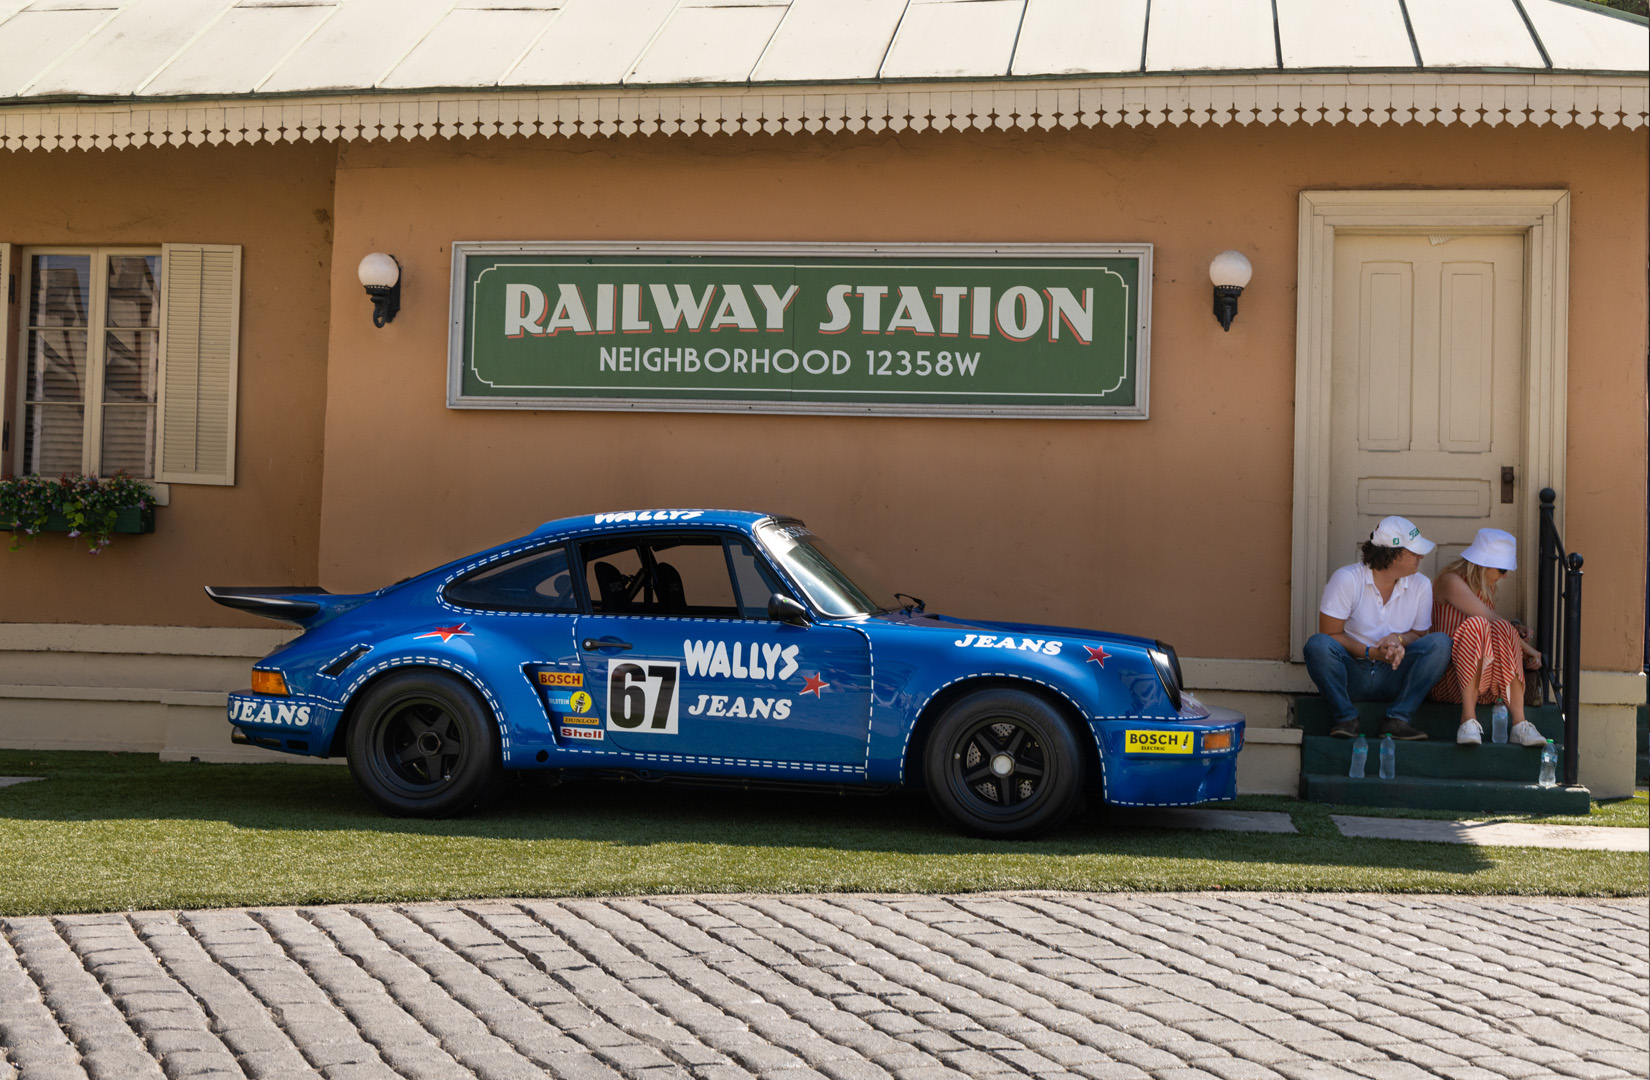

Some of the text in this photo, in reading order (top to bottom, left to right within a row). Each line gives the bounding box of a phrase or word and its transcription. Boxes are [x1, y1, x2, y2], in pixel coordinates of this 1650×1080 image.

[505, 284, 1094, 345] RAILWAY STATION
[600, 347, 981, 376] NEIGHBORHOOD 12358W
[594, 510, 705, 524] WALLYS
[954, 634, 1063, 656] JEANS
[683, 639, 800, 681] WALLYS
[540, 673, 581, 685] BOSCH
[609, 662, 677, 730] 67
[688, 694, 793, 720] JEANS
[229, 700, 311, 727] JEANS
[561, 728, 602, 739] Shell
[1129, 733, 1178, 745] BOSCH
